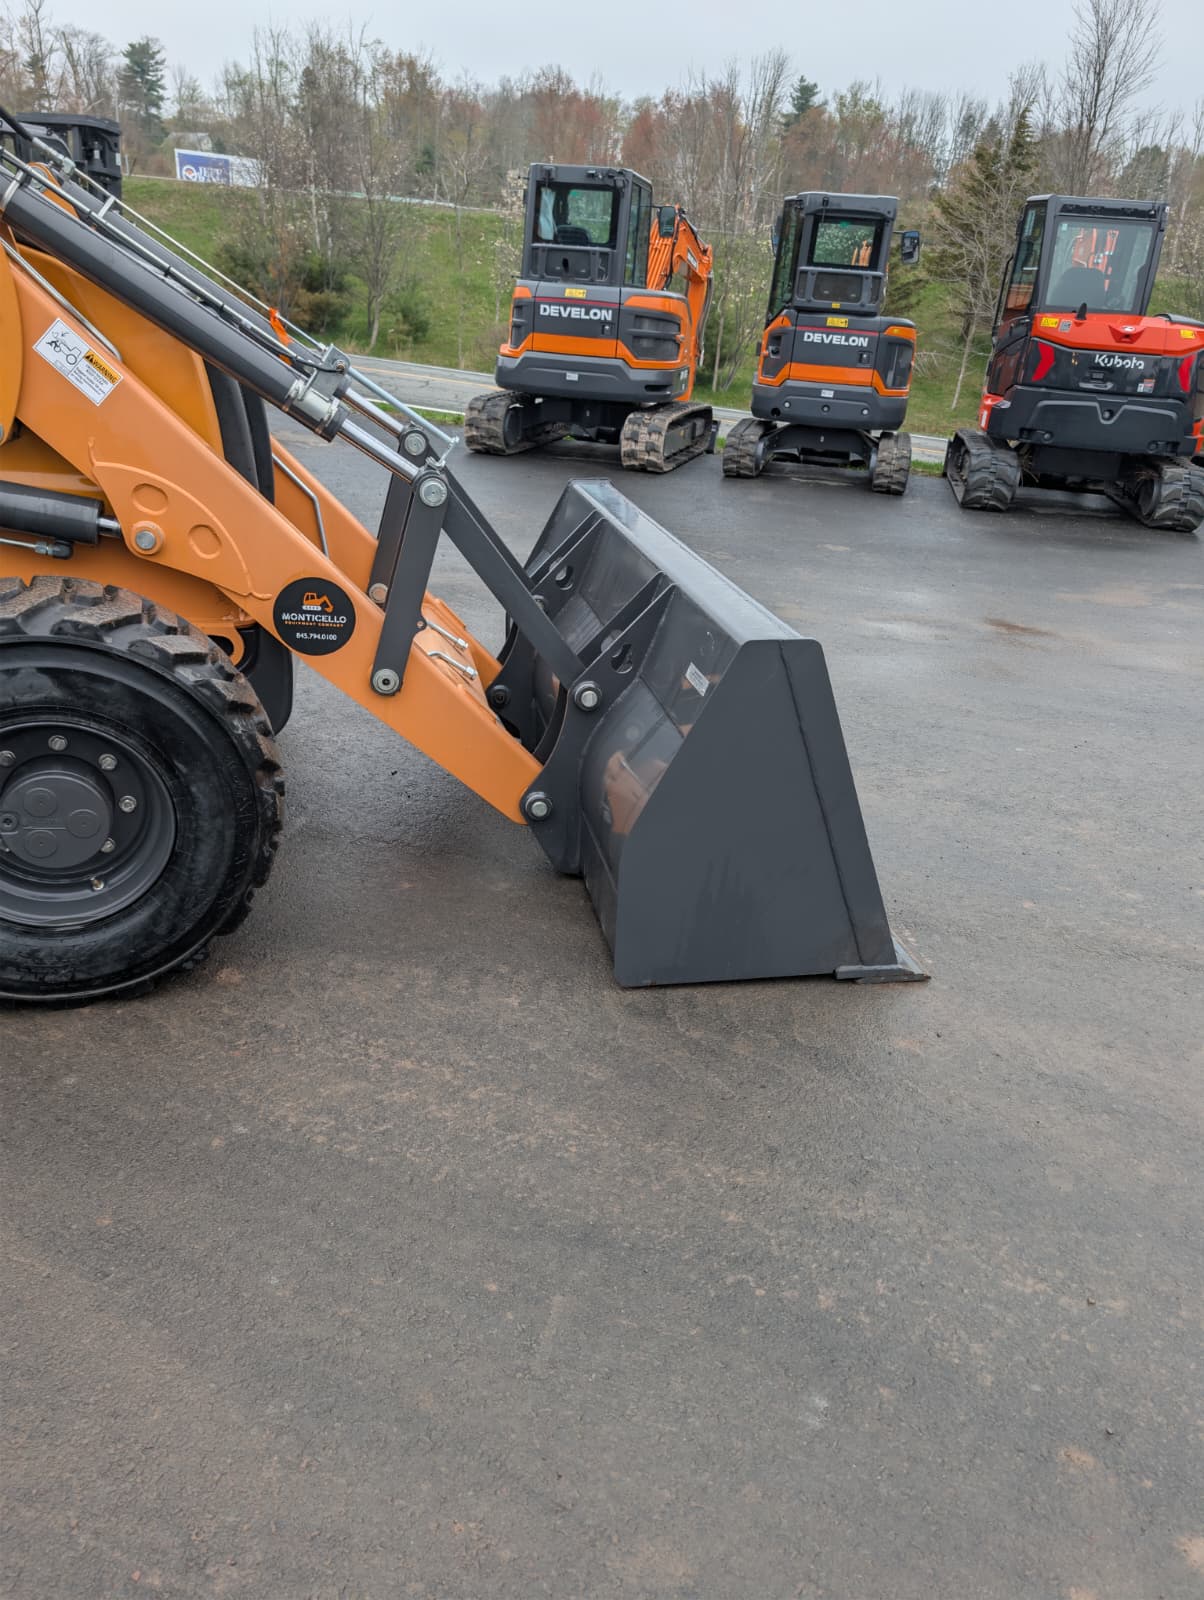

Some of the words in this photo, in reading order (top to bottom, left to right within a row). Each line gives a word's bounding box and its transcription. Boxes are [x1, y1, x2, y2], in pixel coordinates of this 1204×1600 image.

[540, 304, 612, 320] DEVELON
[803, 332, 868, 347] DEVELON
[1094, 354, 1145, 369] Kubota
[92, 360, 118, 384] WARNING
[281, 612, 347, 624] MONTICELLO
